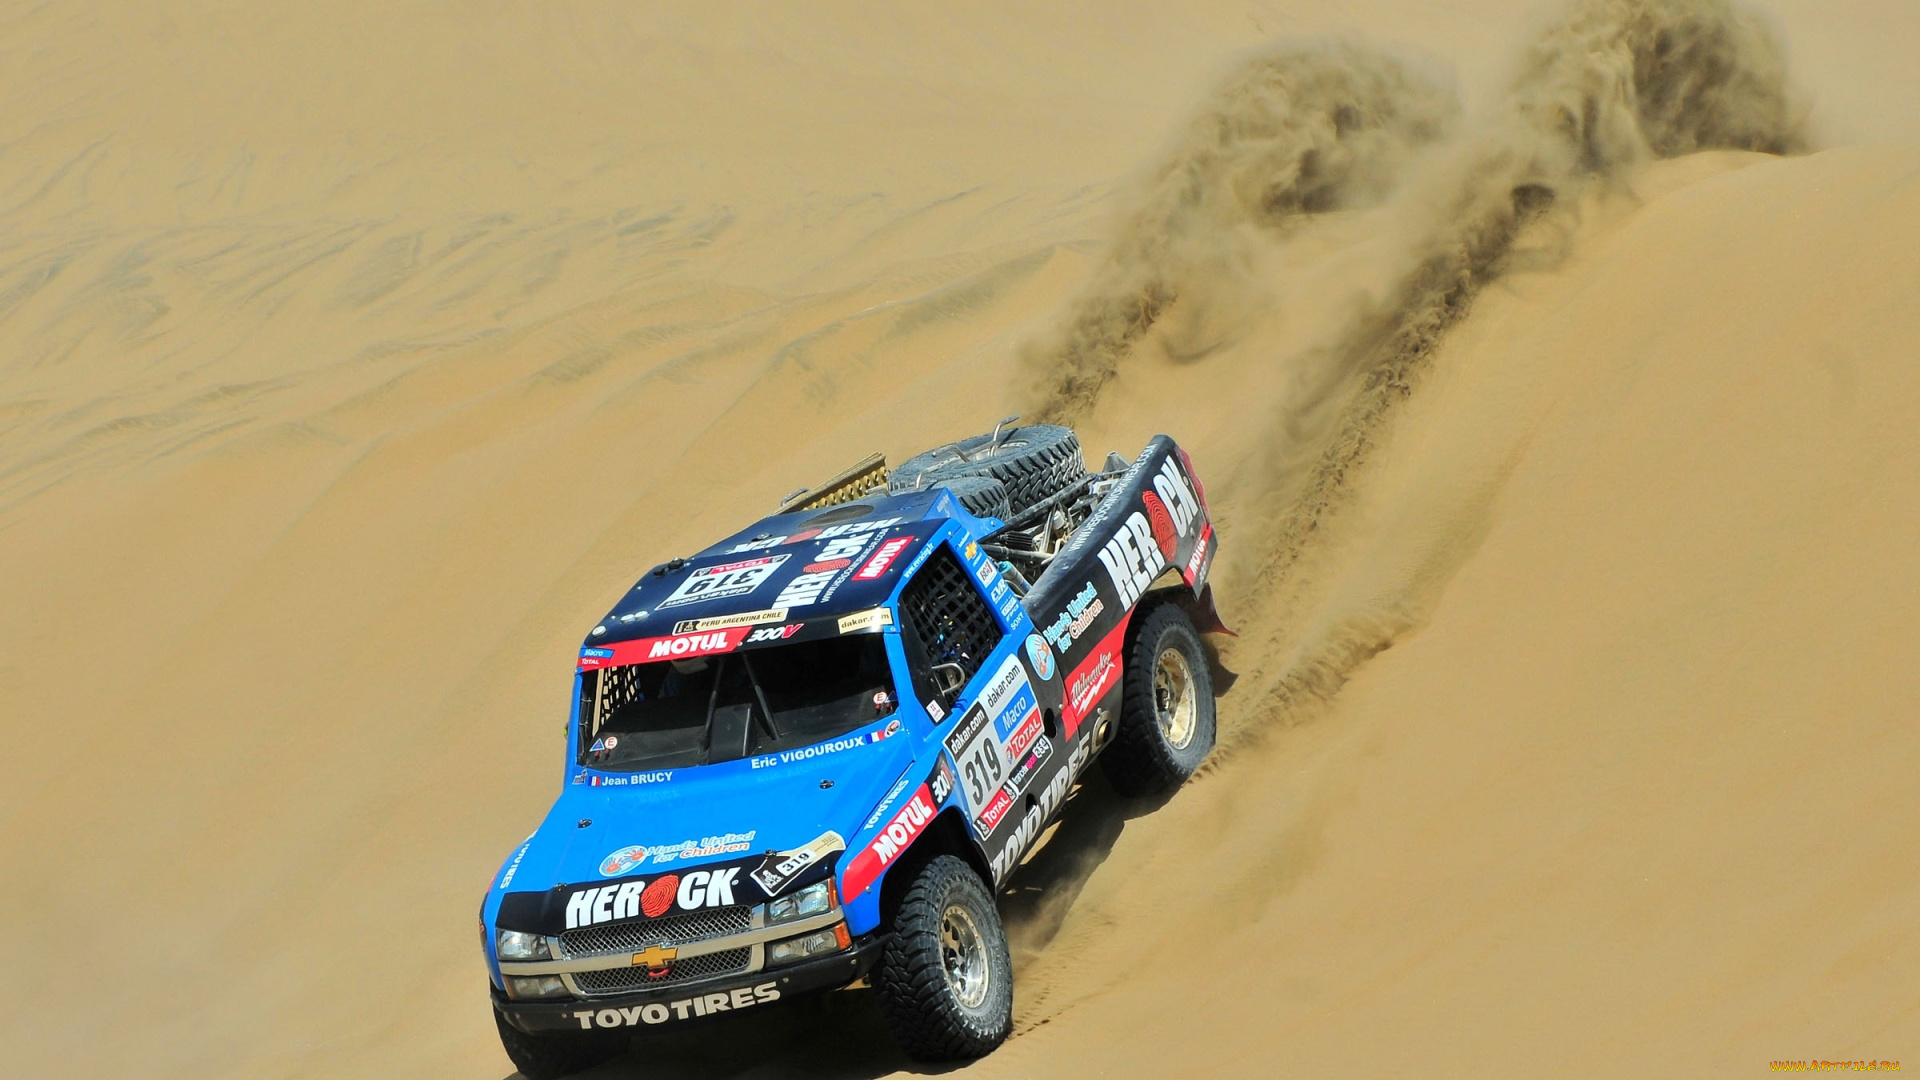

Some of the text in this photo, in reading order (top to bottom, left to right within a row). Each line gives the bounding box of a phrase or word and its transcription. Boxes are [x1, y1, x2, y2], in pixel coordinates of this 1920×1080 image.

[859, 538, 908, 578] MOTUL
[664, 587, 750, 606] dakar.com
[684, 568, 763, 595] 319
[701, 611, 782, 627] PERU ARGENTINA CHILE
[1010, 612, 1024, 631] SONY
[1043, 581, 1098, 646] Hands United
[1057, 599, 1104, 654] for Children
[584, 648, 604, 657] Macro
[648, 623, 804, 658] MOTUL 300V
[987, 664, 1021, 708] dakar.com
[1072, 652, 1112, 709] Milwaukee
[1002, 697, 1026, 731] Macro
[950, 709, 985, 754] dakar.com
[751, 736, 865, 769] Eric VIGOUROUX
[602, 776, 628, 786] Jean
[631, 771, 673, 785] BRUCY
[965, 737, 1001, 806] 319
[863, 803, 889, 830] TOYO
[871, 796, 933, 865] MOTUL
[646, 830, 756, 857] Hands United
[652, 842, 750, 864] for Children
[992, 805, 1041, 886] TOYO
[782, 852, 810, 872] 319
[574, 981, 781, 1030] TOYO TIRES
